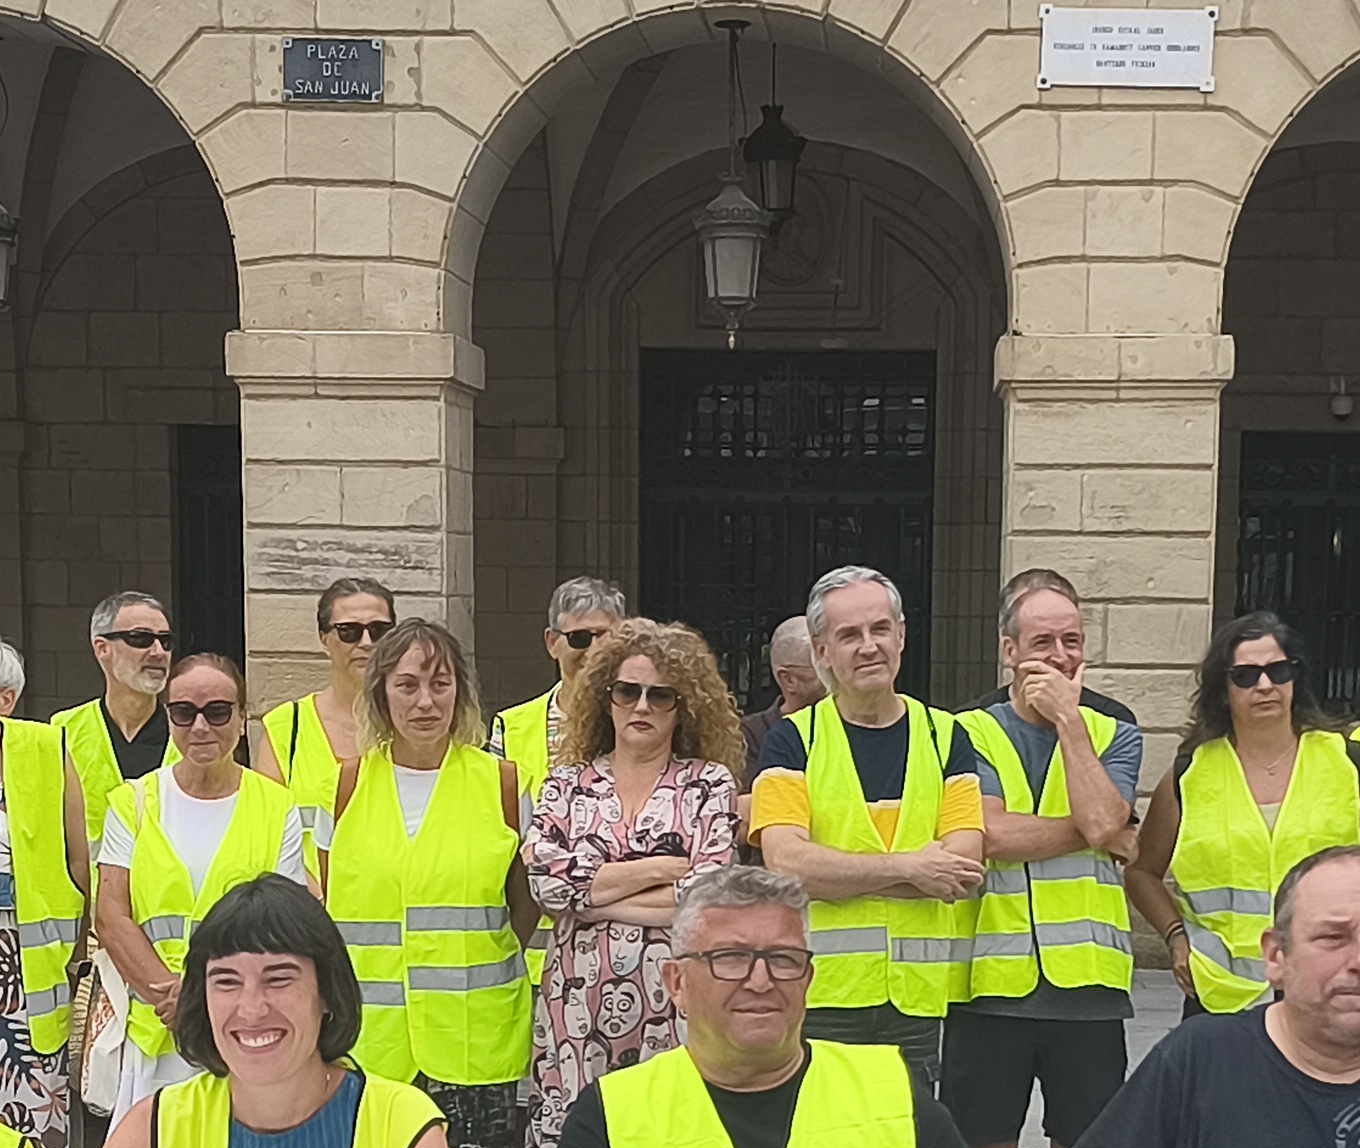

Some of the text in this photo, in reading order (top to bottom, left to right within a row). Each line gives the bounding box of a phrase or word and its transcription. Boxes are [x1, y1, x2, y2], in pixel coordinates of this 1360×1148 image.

[307, 44, 359, 59] PLAZA
[322, 62, 343, 77] DE
[295, 79, 370, 95] SAN JUAN
